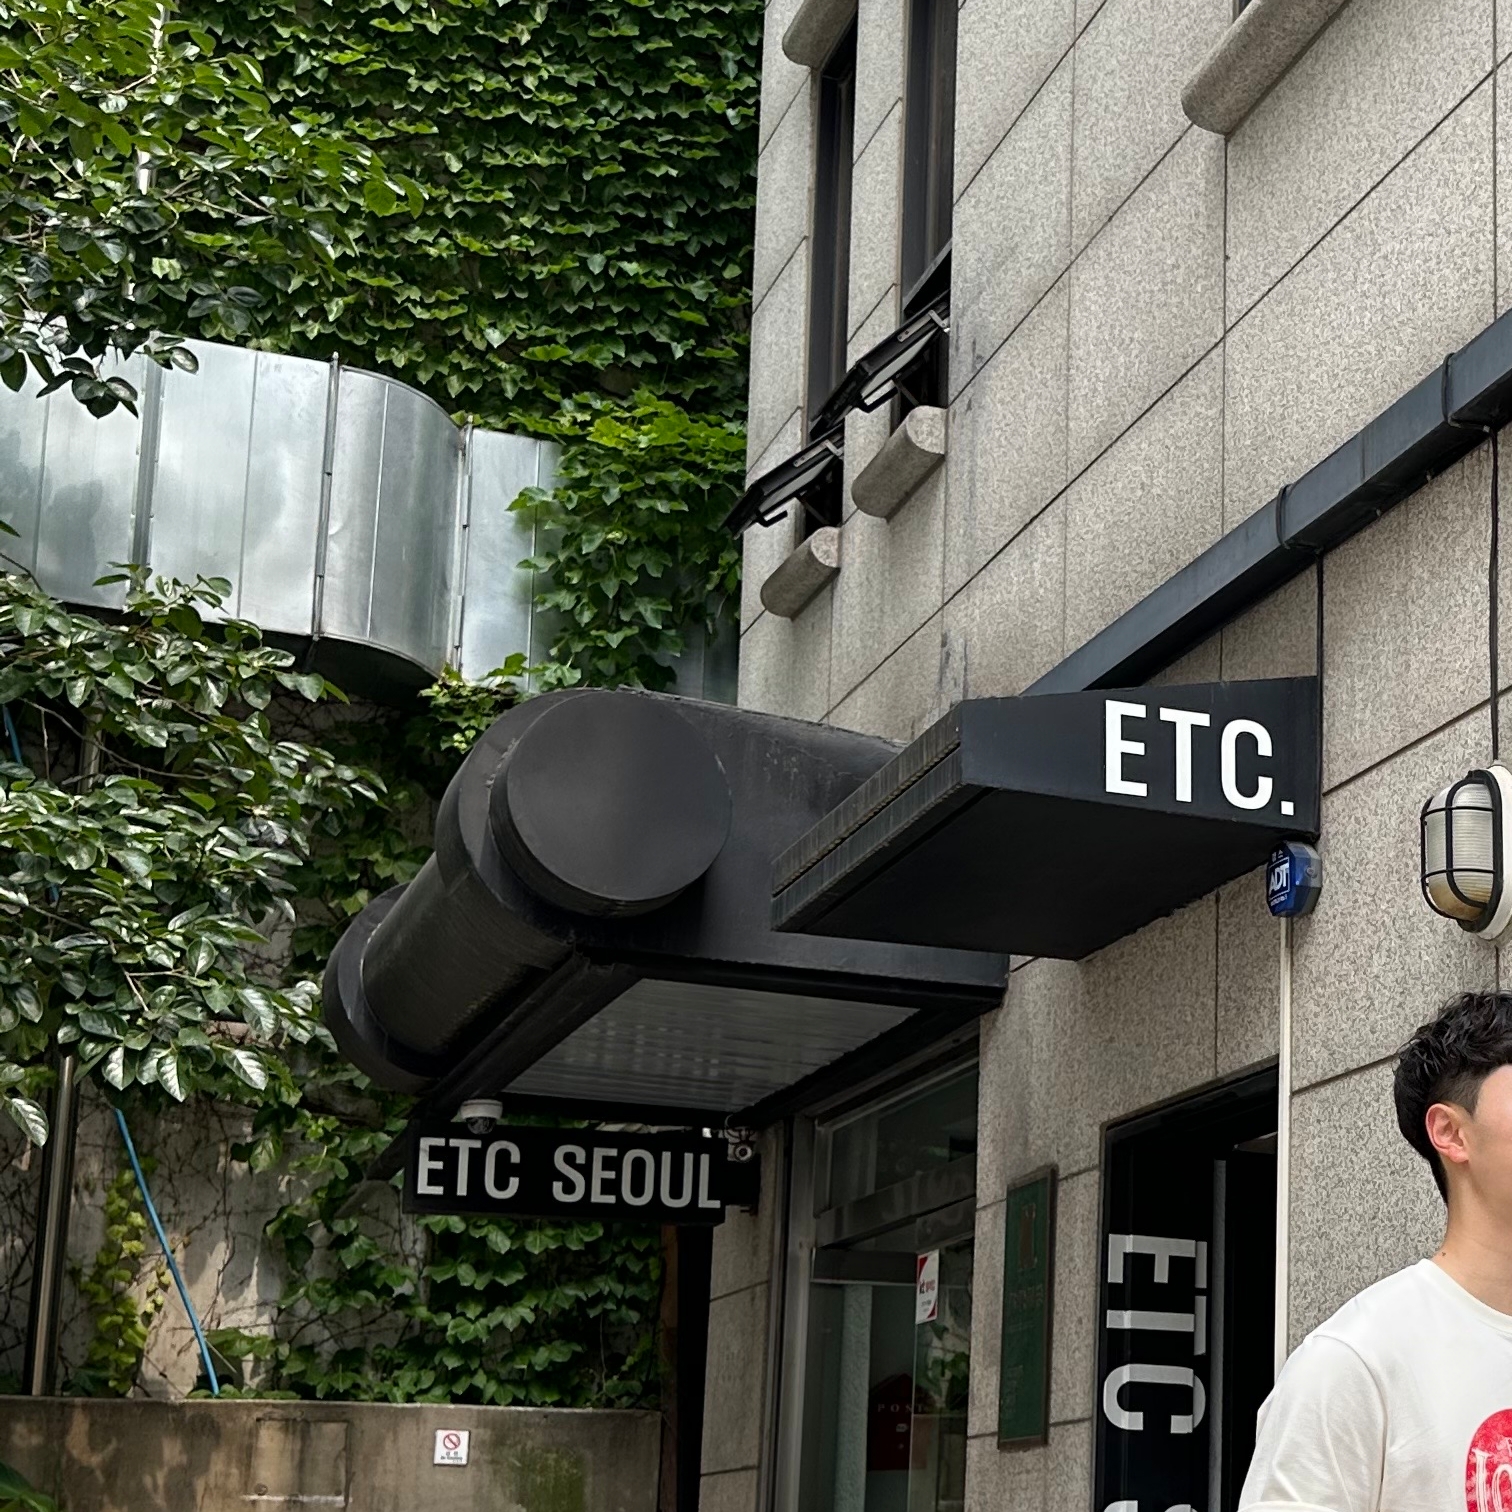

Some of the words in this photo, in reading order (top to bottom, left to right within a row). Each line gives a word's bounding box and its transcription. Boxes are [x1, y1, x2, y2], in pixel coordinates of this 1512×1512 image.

[1105, 699, 1294, 816] ETC.
[1268, 862, 1290, 897] ADT
[417, 1137, 521, 1200] ETC
[552, 1144, 721, 1209] SEOUL
[1103, 1233, 1208, 1434] ETC
[877, 1403, 923, 1413] POST
